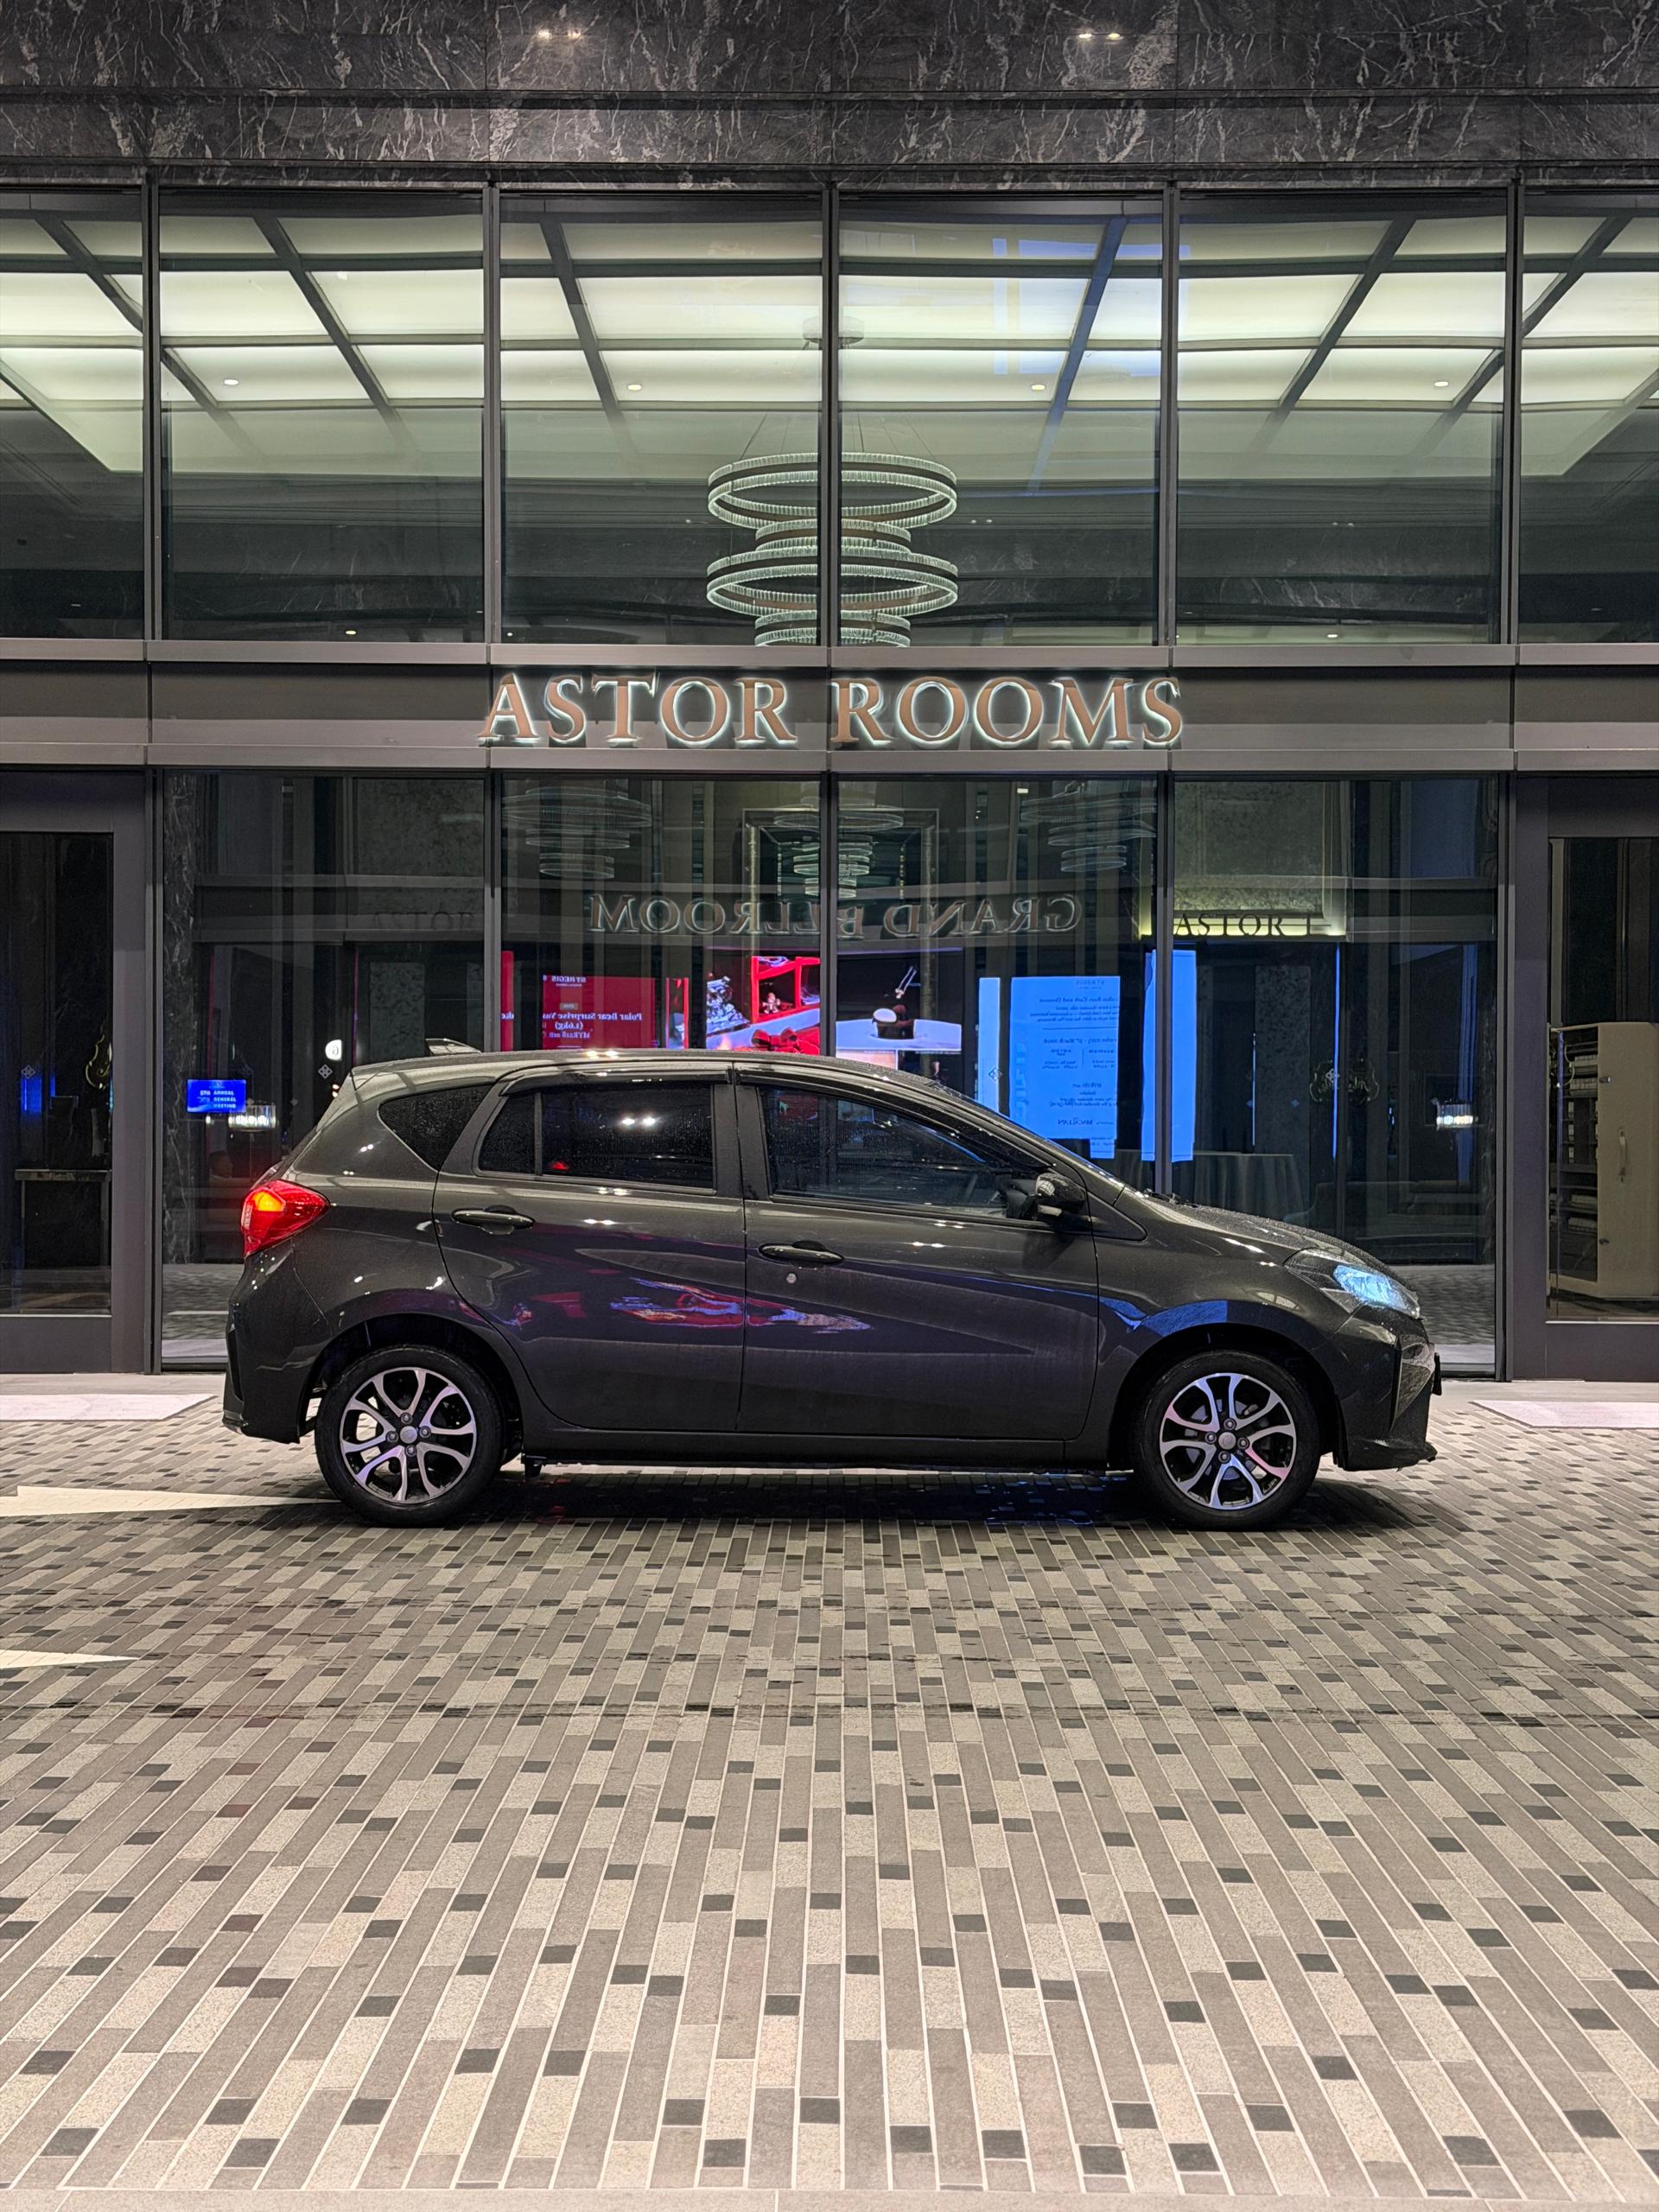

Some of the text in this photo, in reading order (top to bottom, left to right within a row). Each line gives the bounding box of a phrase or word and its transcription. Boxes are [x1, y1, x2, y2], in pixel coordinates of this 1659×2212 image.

[475, 672, 1182, 746] ASTOR ROOMS
[1173, 912, 1286, 937] ASTOR
